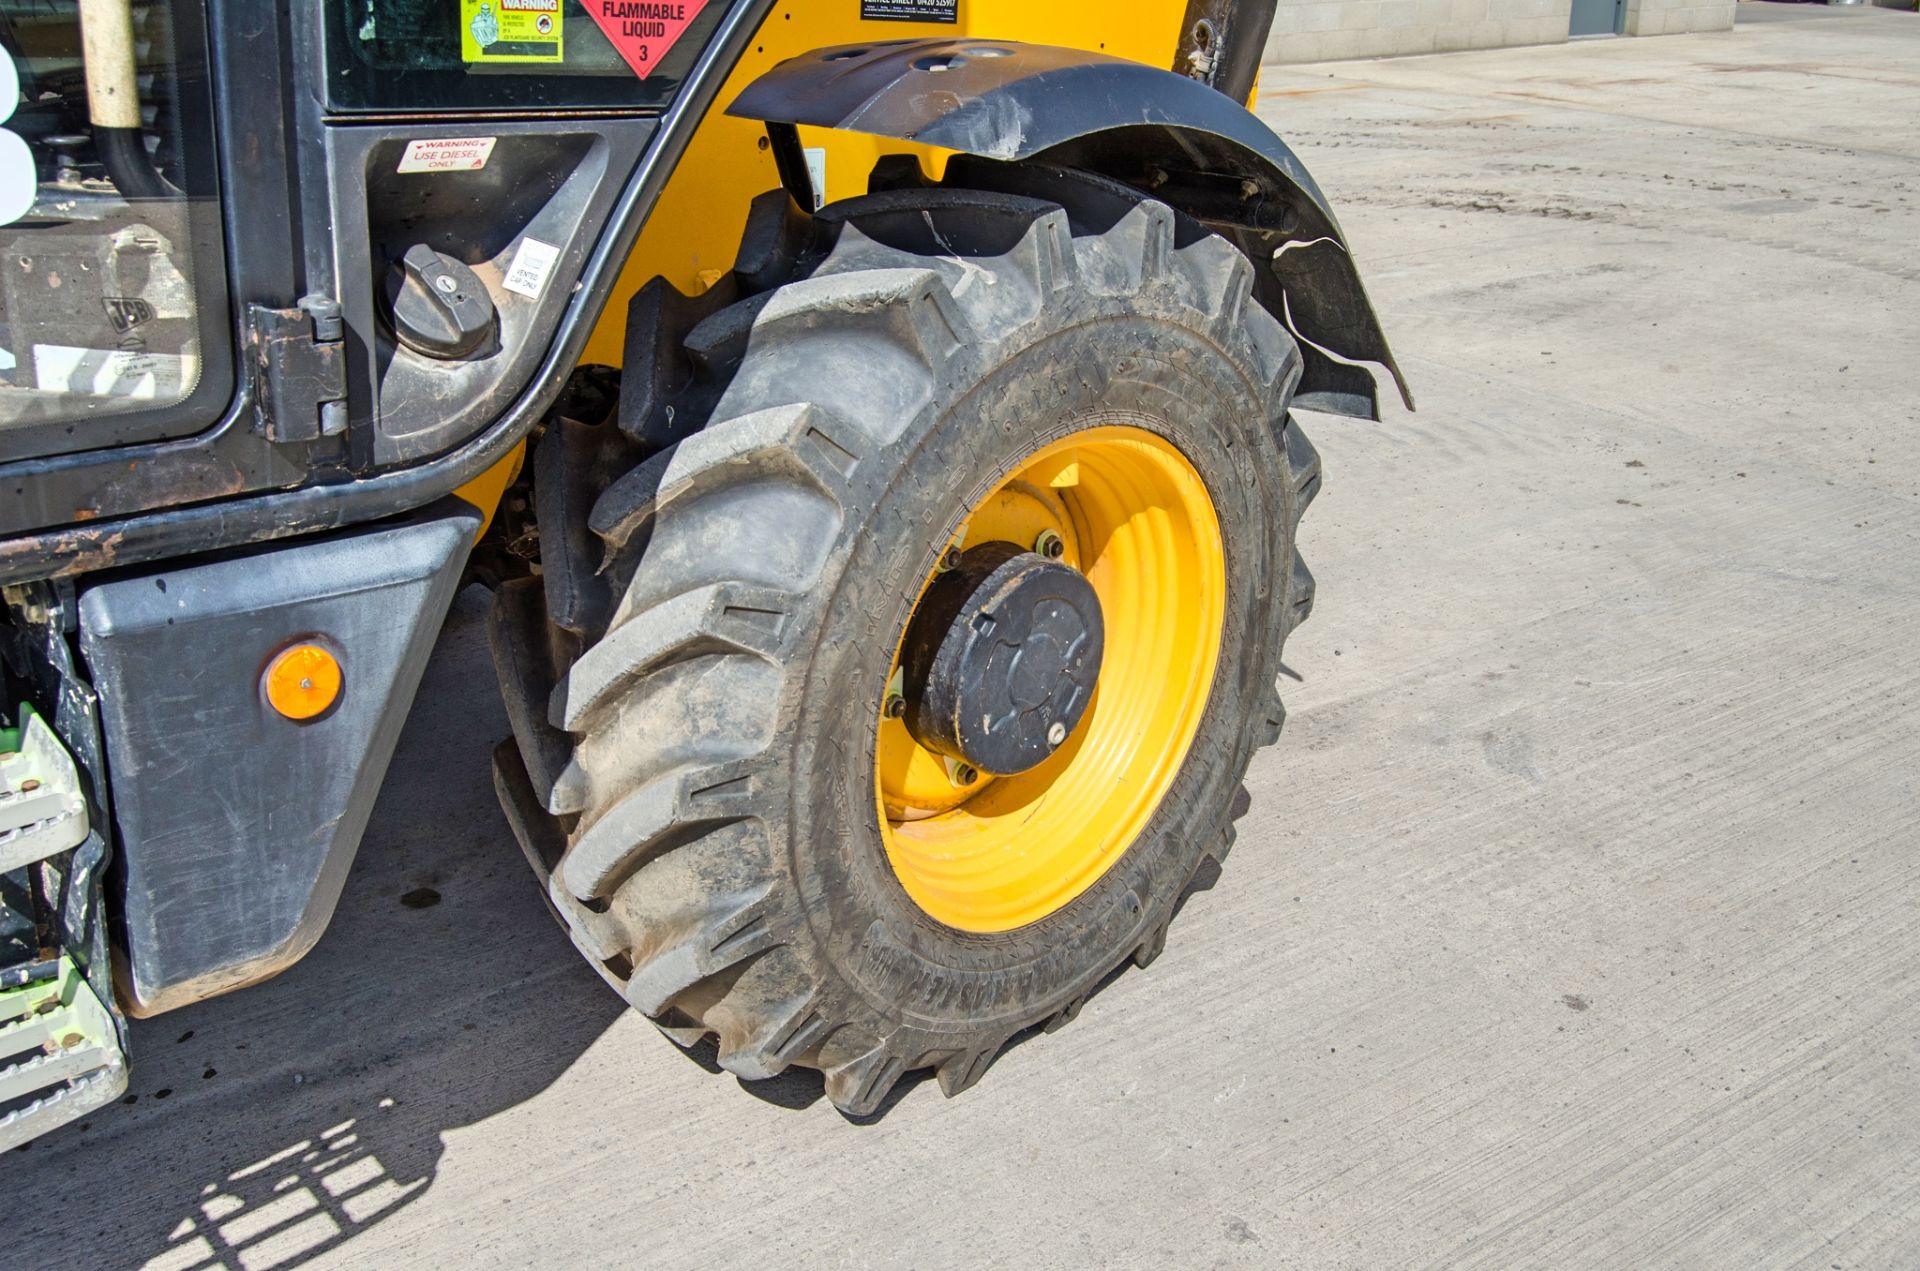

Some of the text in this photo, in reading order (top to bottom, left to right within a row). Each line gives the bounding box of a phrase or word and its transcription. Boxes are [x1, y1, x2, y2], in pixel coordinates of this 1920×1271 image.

[503, 0, 557, 10] WARNING
[603, 1, 685, 20] FLAMMABLE
[623, 21, 665, 38] LIQUID
[639, 45, 648, 61] 3
[425, 140, 479, 149] WARNING
[414, 150, 480, 160] USE DIESEL
[517, 269, 539, 281] VENTED
[110, 301, 150, 330] JCB
